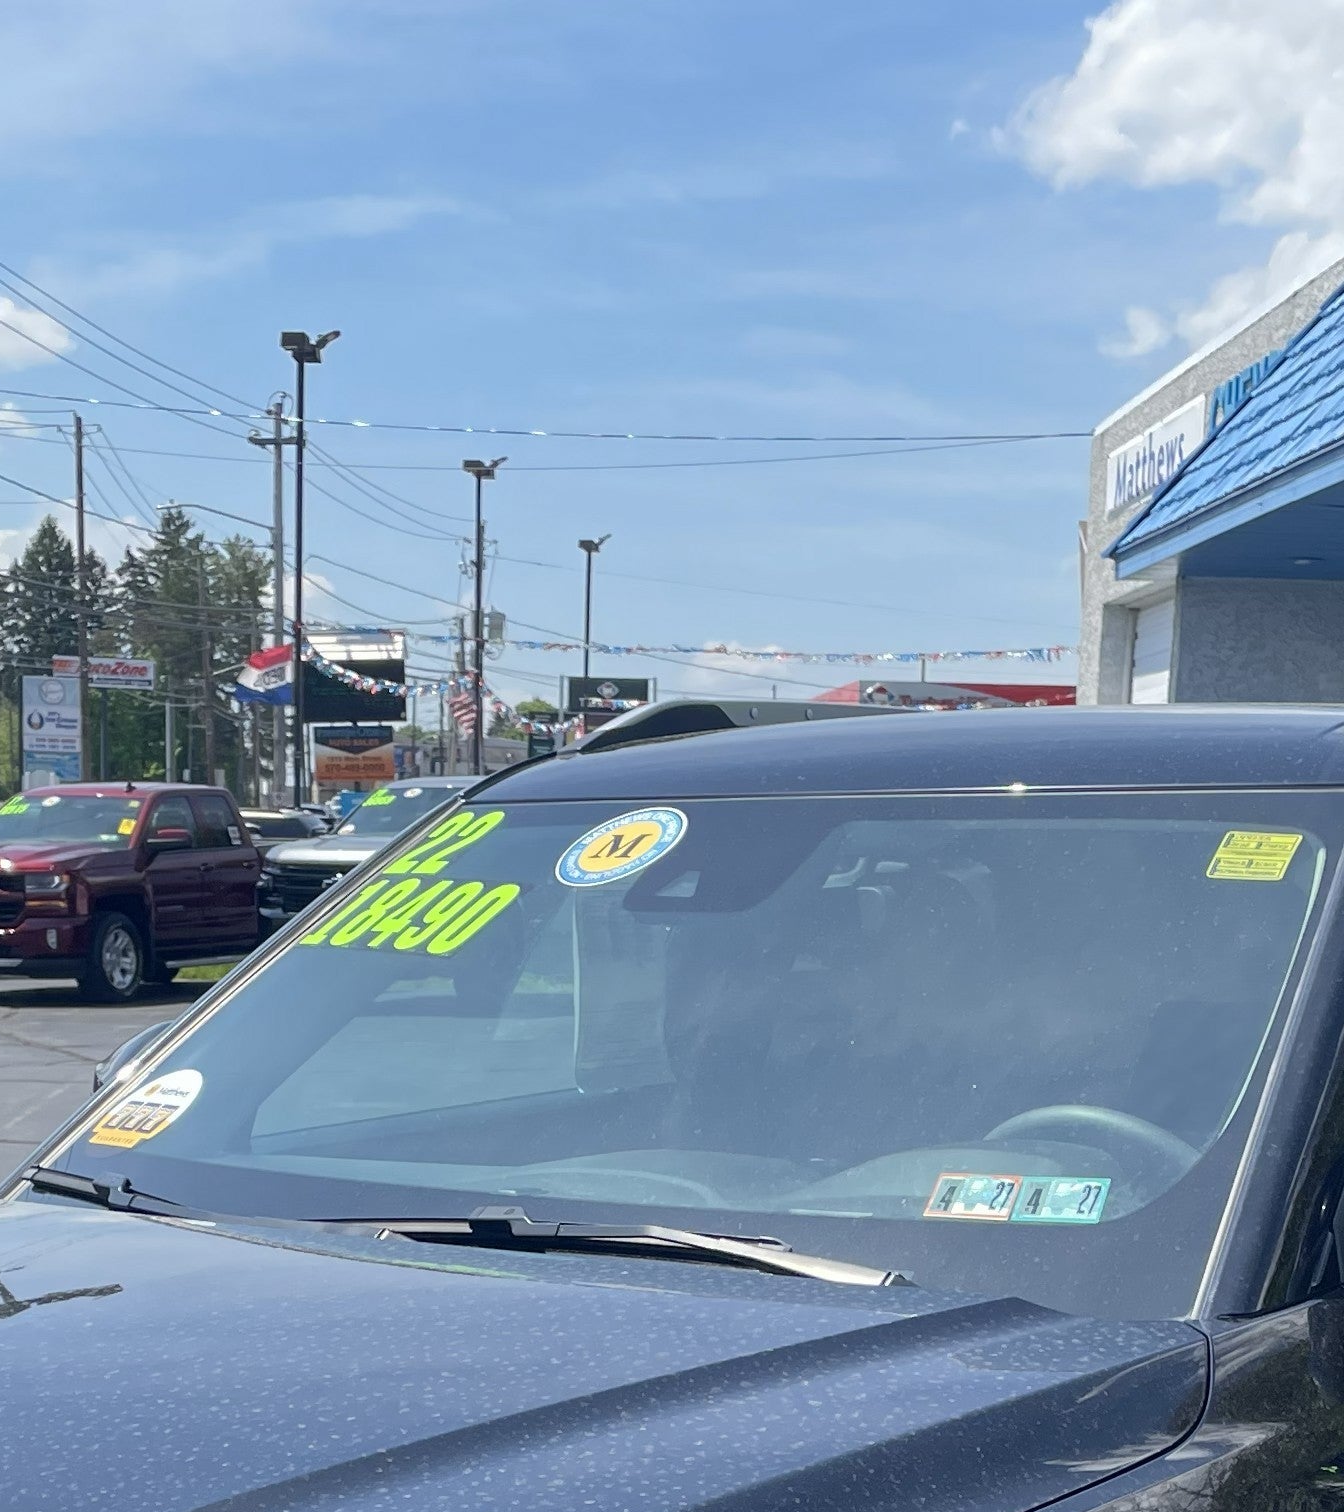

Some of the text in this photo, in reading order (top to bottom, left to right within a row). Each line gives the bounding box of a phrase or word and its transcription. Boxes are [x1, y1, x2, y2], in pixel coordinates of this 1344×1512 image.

[1114, 432, 1185, 507] Matthews
[383, 811, 505, 874] 22
[588, 833, 653, 859] M
[299, 878, 520, 954] 18490
[937, 1185, 957, 1212] 4
[1025, 1188, 1044, 1215] 4
